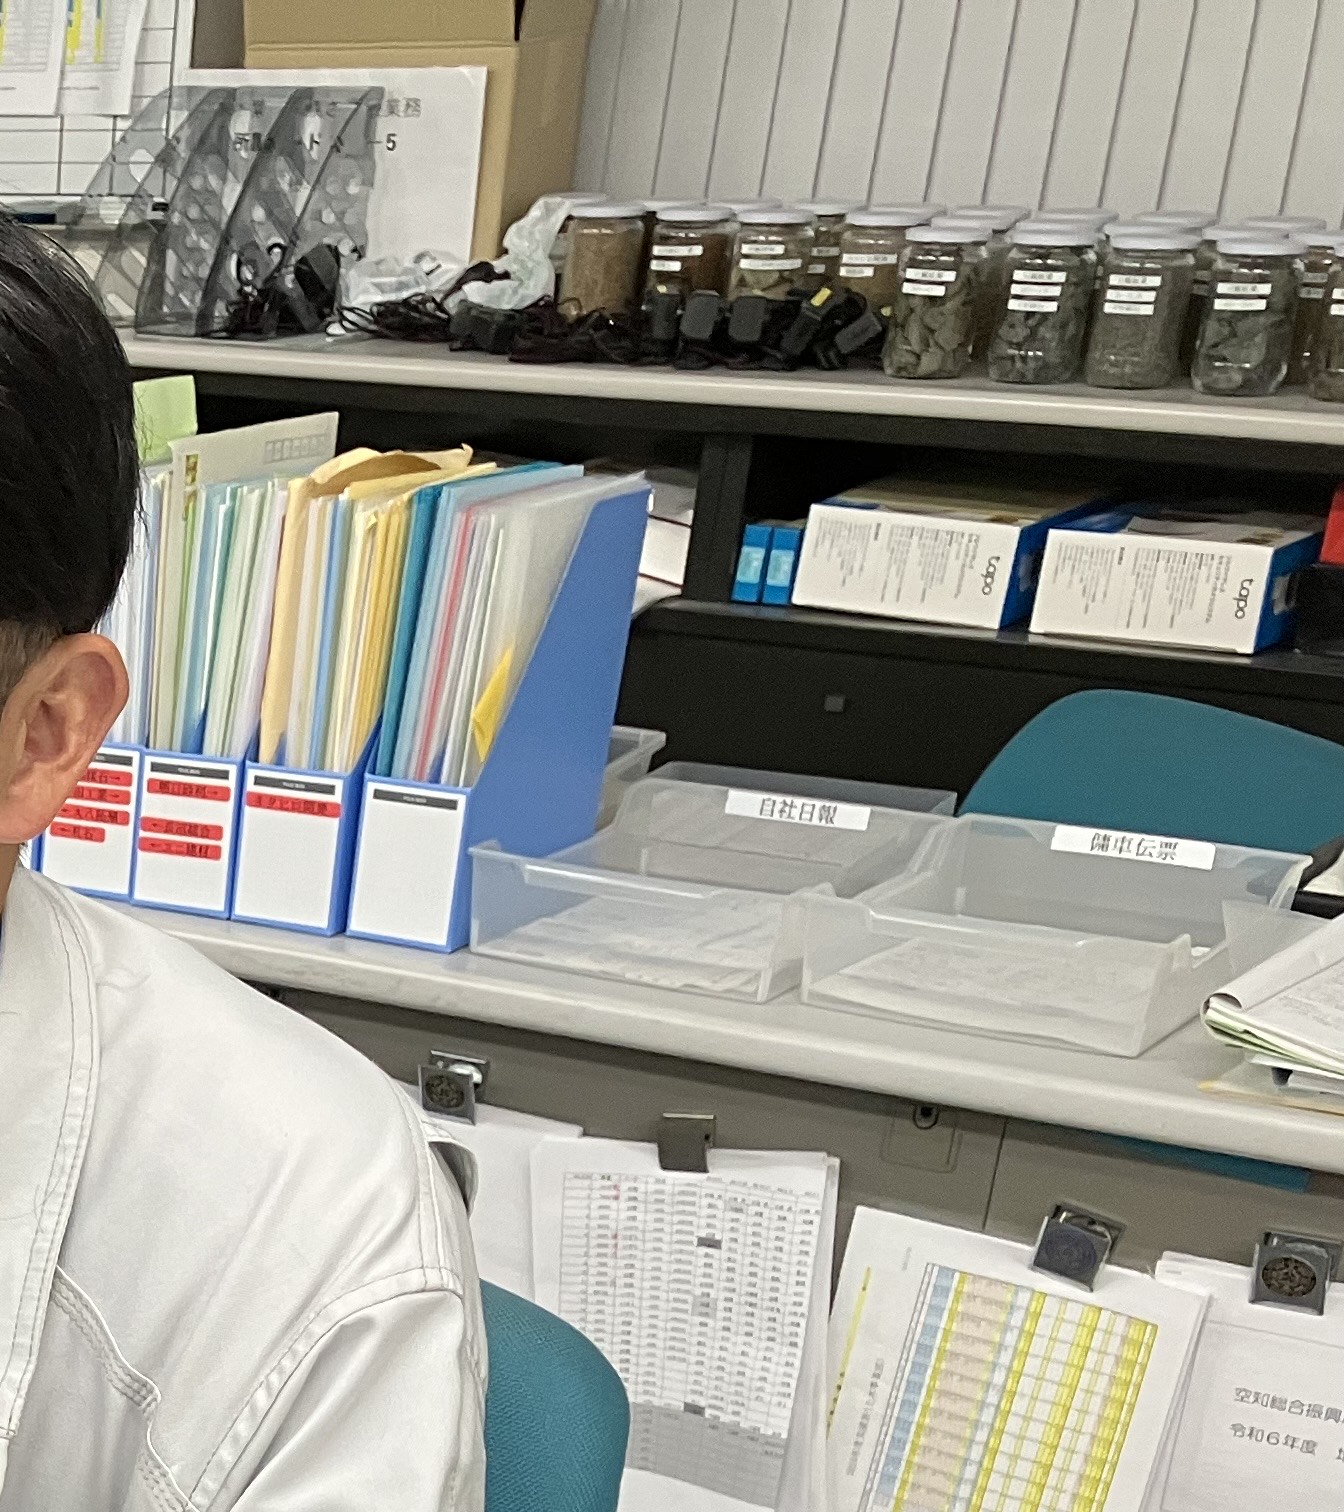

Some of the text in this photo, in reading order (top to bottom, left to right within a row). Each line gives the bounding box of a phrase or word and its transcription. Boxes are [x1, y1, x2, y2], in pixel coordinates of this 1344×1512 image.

[981, 555, 1001, 596] tapo
[1232, 577, 1254, 620] tapo
[759, 796, 837, 826] 自社日報
[1234, 1387, 1344, 1424] 空知総合振興
[1229, 1422, 1319, 1456] 令和6年度
